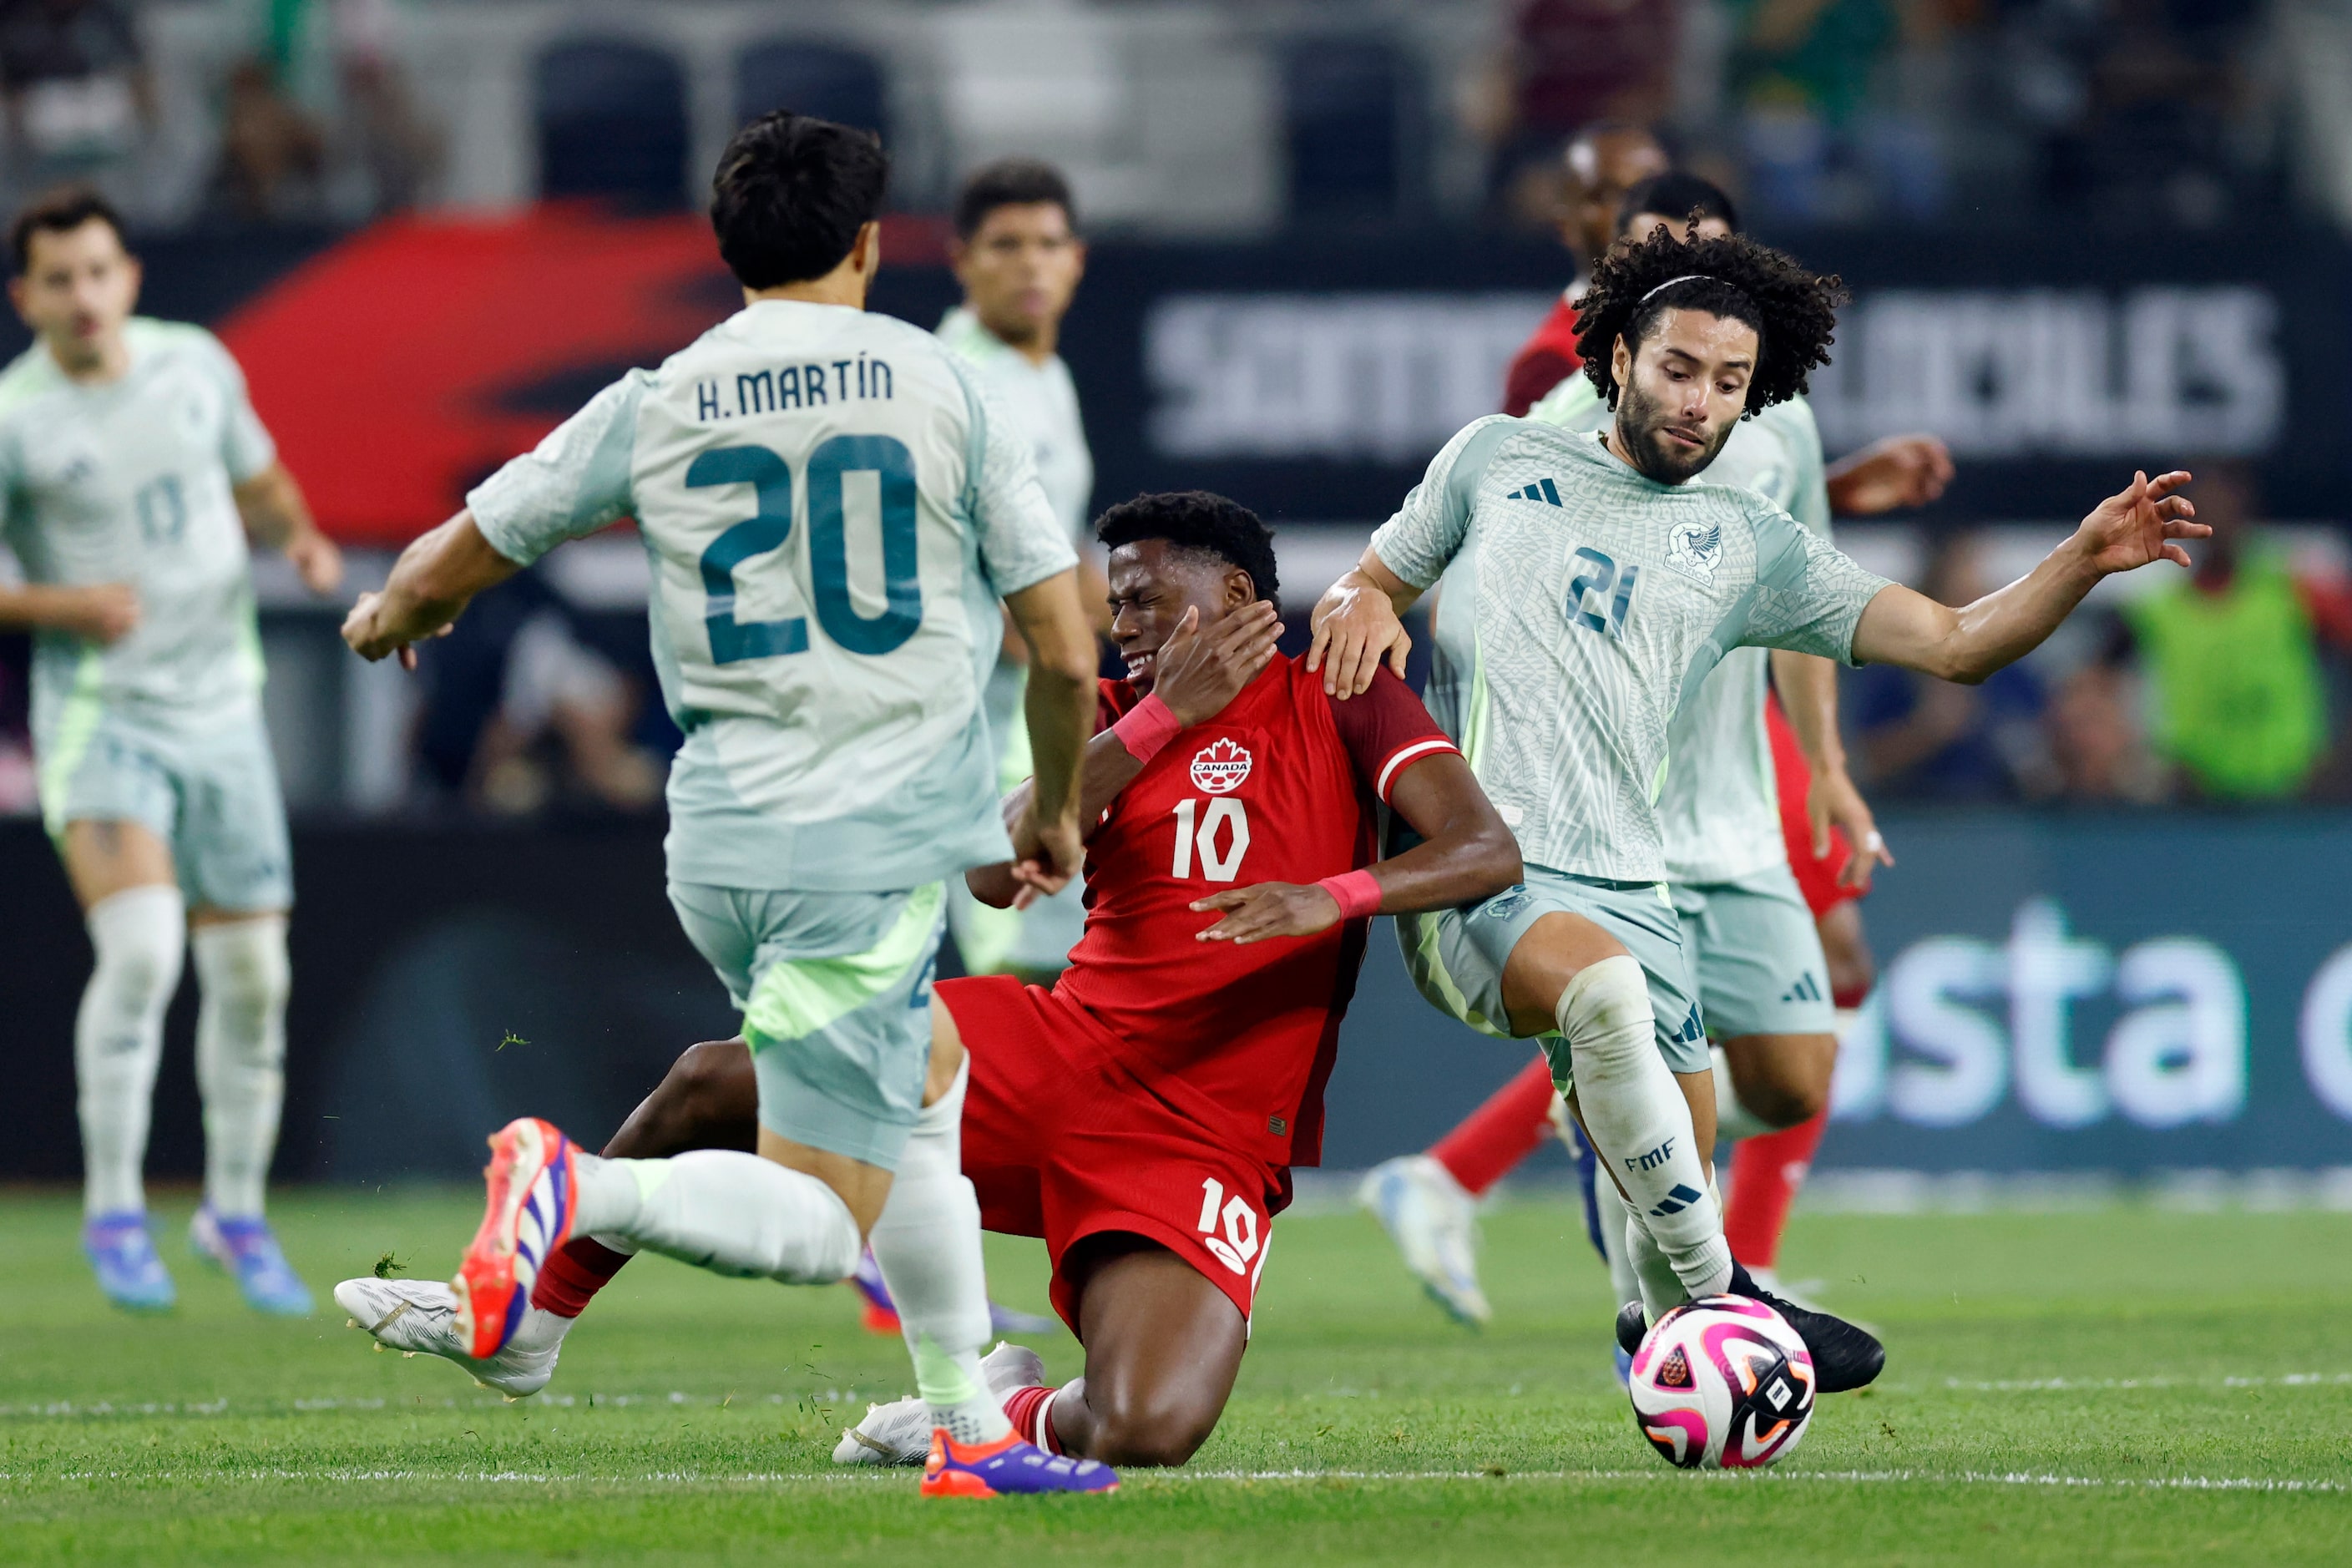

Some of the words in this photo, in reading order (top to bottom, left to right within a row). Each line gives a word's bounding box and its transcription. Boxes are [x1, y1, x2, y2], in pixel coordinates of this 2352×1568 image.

[685, 433, 923, 666] 20
[1565, 546, 1639, 641] 21
[1192, 763, 1248, 772] CANADA
[1171, 796, 1251, 883] 10
[1624, 1136, 1676, 1172] FMF
[1196, 1176, 1259, 1263] 10
